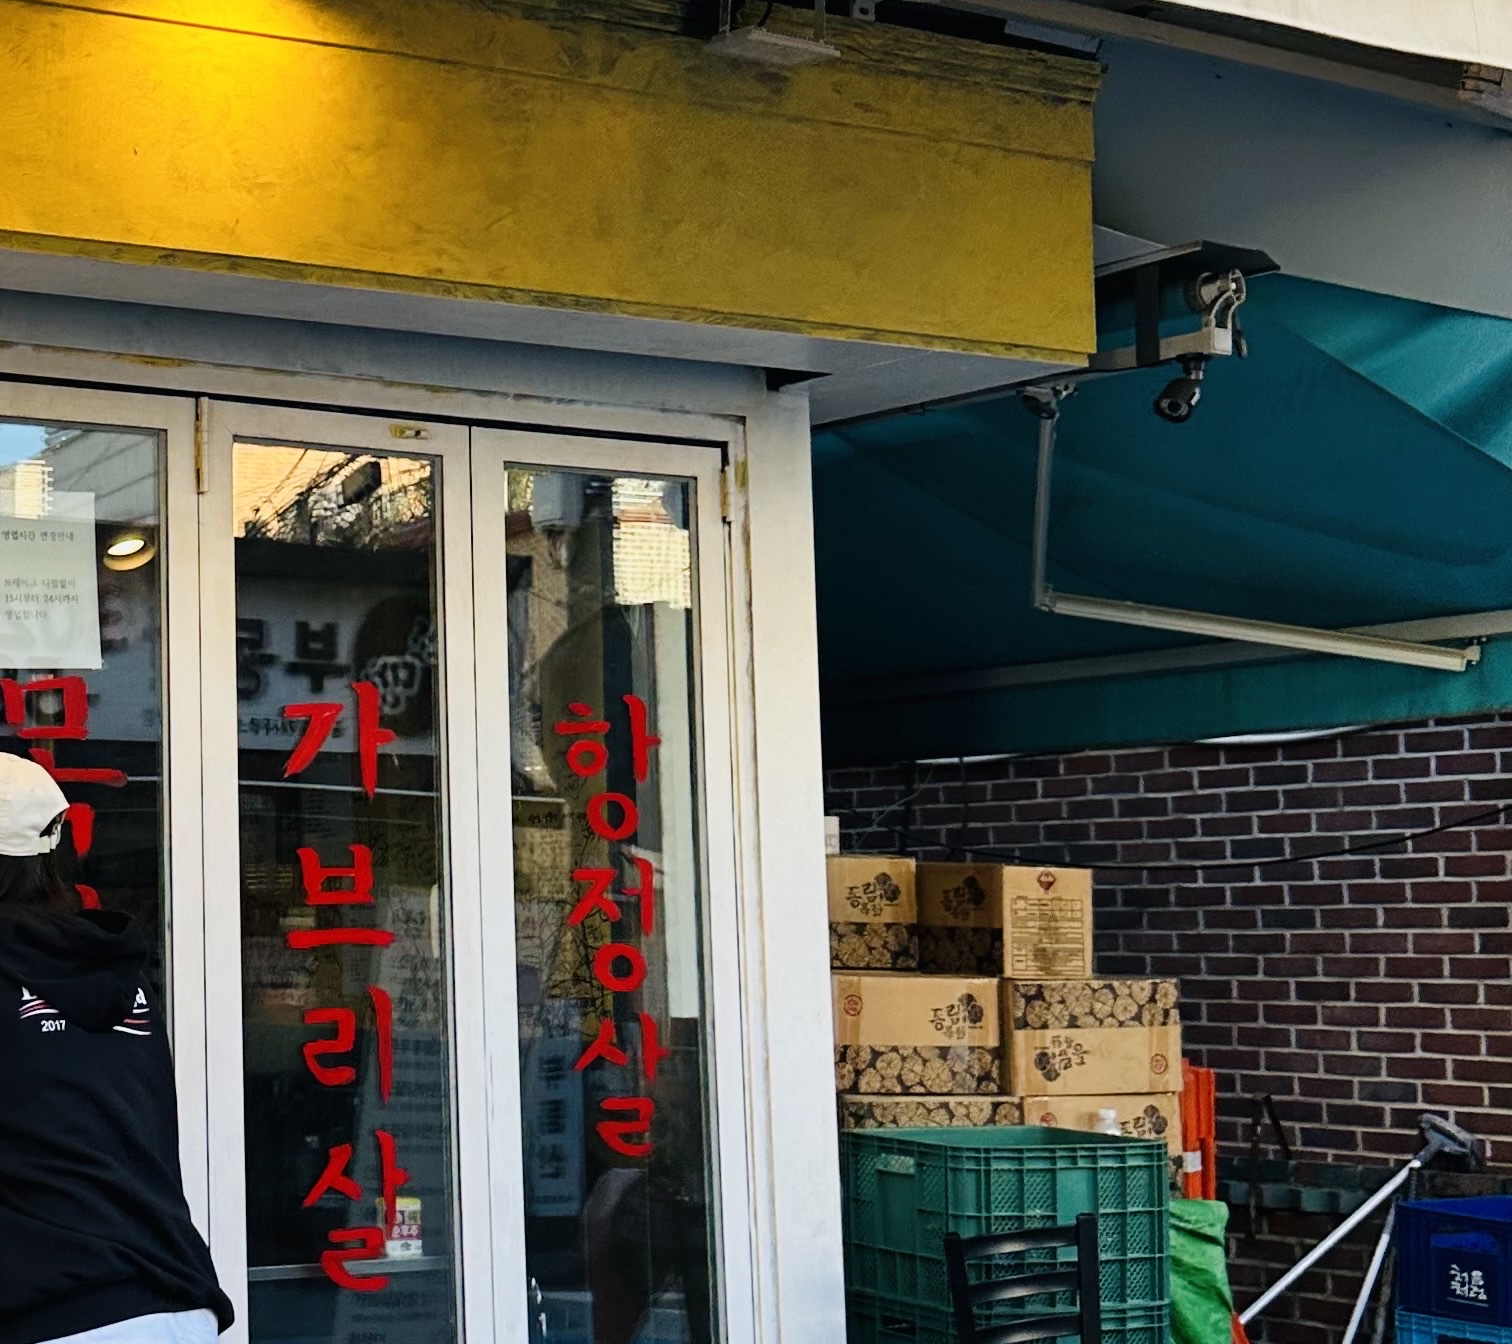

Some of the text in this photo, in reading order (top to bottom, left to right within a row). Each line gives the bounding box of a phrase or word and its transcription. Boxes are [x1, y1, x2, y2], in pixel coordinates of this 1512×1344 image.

[40, 1019, 66, 1033] 2017
[280, 680, 414, 1292] 가브리살
[551, 691, 672, 1158] 항정살
